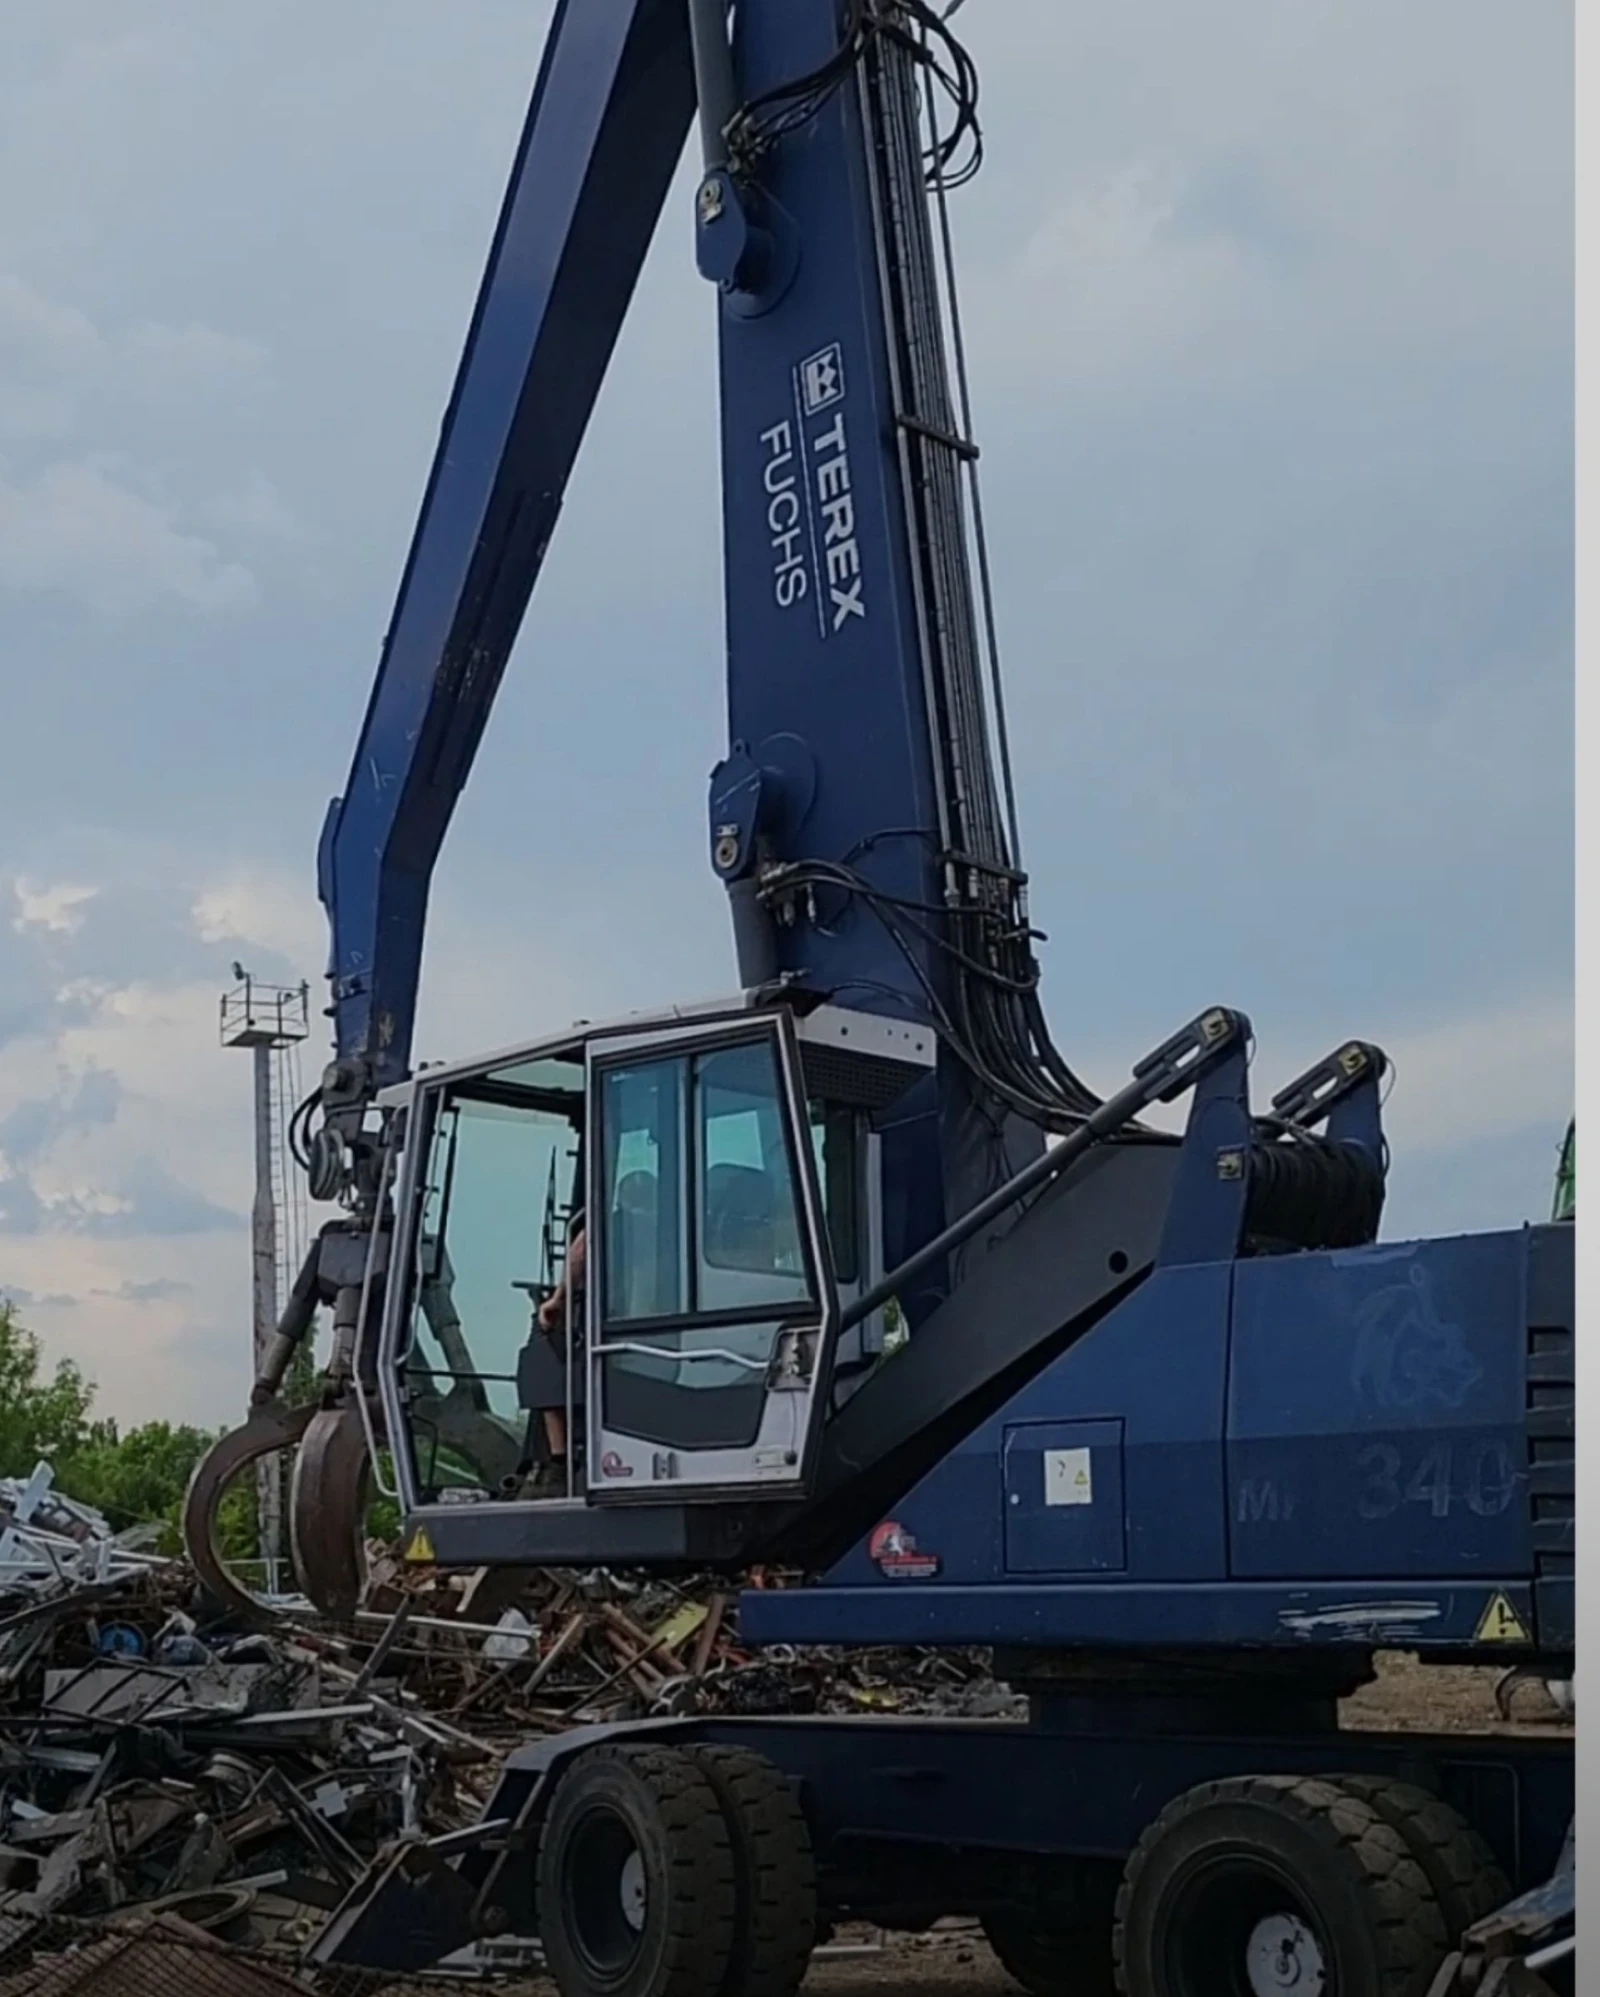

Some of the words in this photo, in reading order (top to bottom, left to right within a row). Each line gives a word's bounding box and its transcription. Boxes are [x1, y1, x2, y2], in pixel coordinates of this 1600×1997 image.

[760, 420, 808, 607] FUCHS
[814, 412, 865, 632] TEREX
[1355, 1438, 1515, 1519] 340
